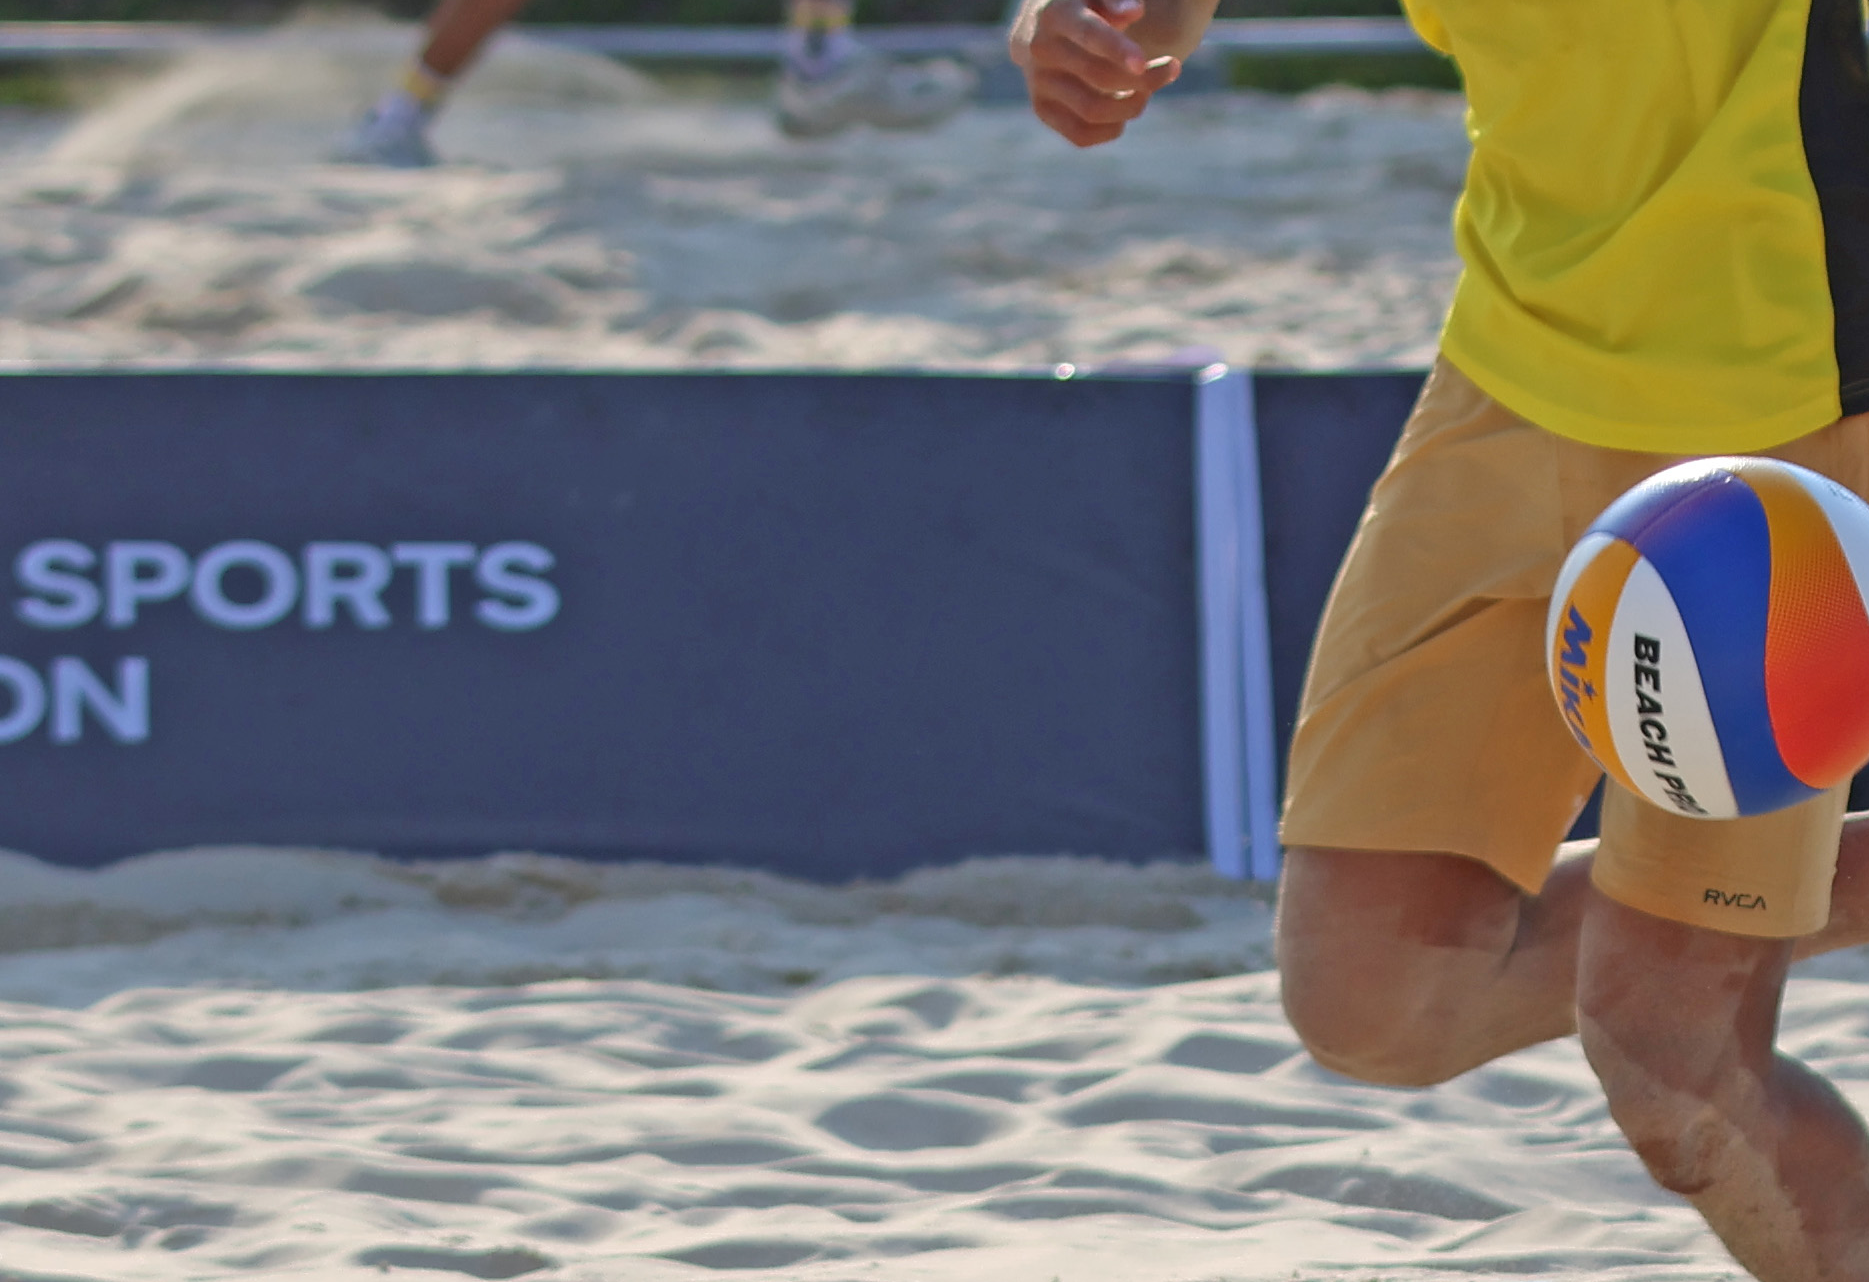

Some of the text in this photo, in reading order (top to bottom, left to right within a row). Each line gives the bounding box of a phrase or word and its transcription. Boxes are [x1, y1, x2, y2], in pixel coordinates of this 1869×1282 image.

[18, 539, 560, 630] SPORTS
[1634, 632, 1677, 768] BEACH
[1703, 887, 1767, 911] RVCA
